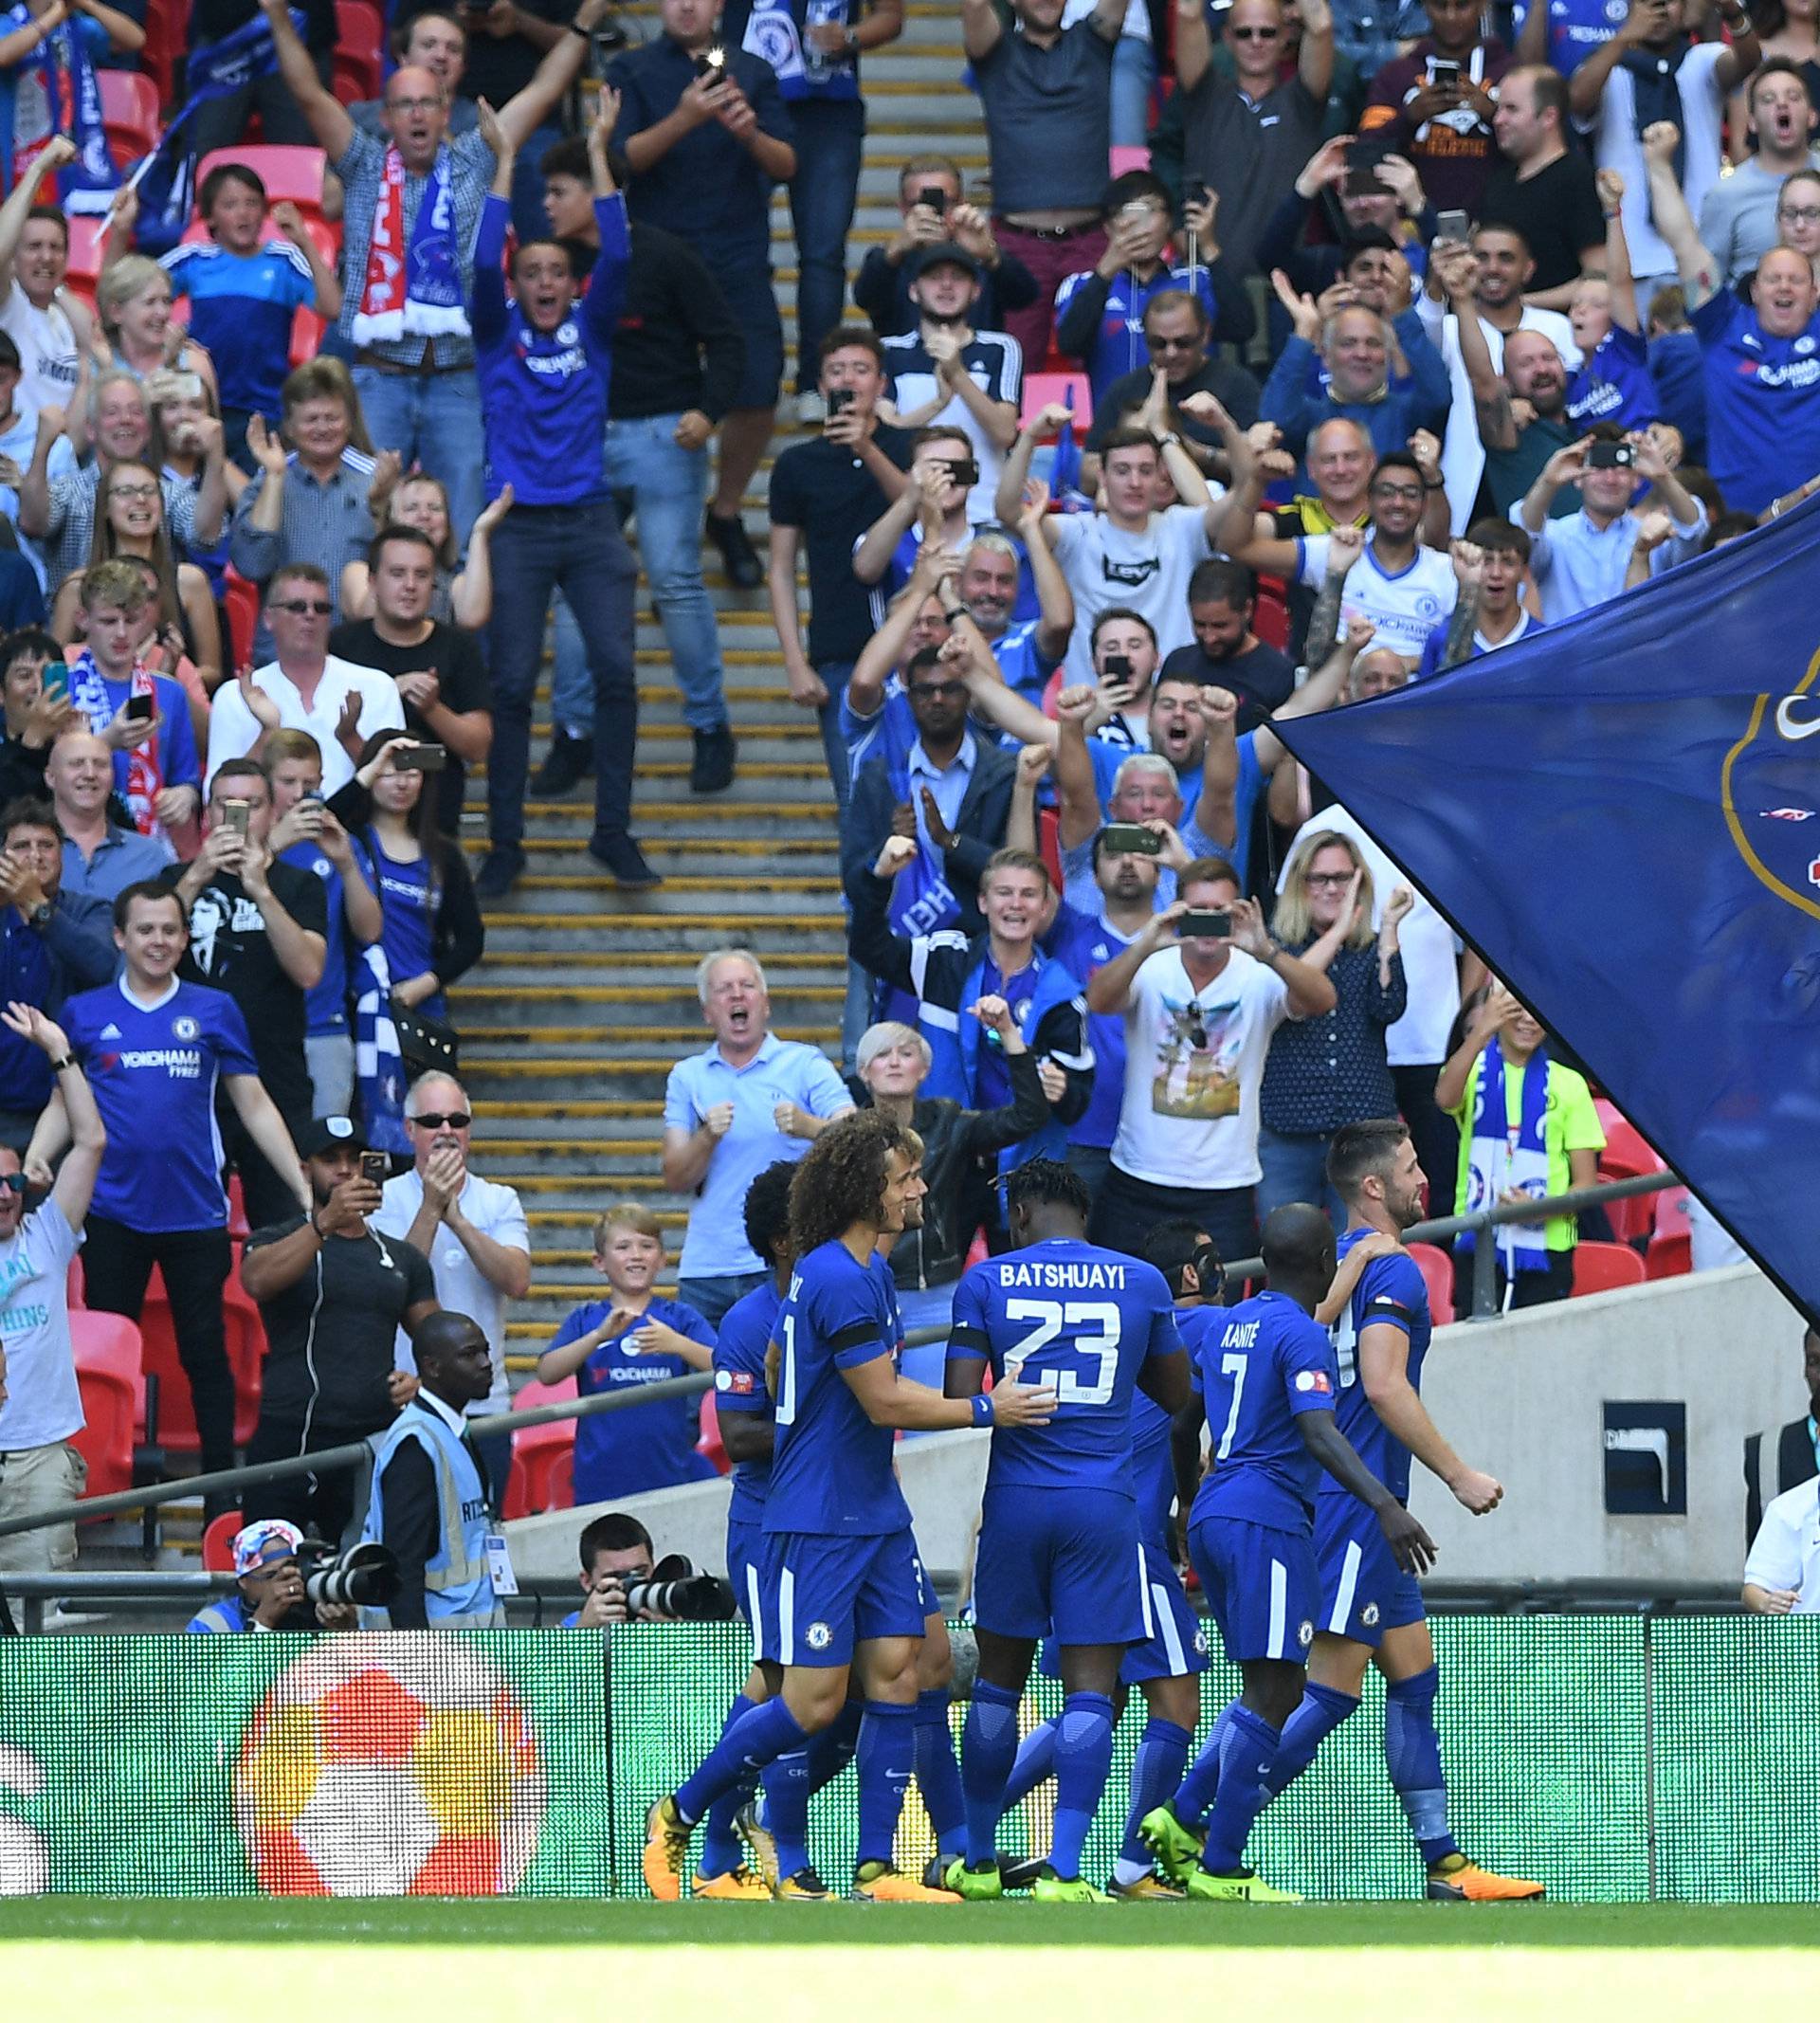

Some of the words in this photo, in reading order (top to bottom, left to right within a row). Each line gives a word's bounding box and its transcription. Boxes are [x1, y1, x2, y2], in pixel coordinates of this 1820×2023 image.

[1000, 1263, 1125, 1290] BATSHUAYI
[1003, 1298, 1121, 1405] 23
[1220, 1320, 1261, 1348] KANTÉ
[1216, 1353, 1248, 1460] 7
